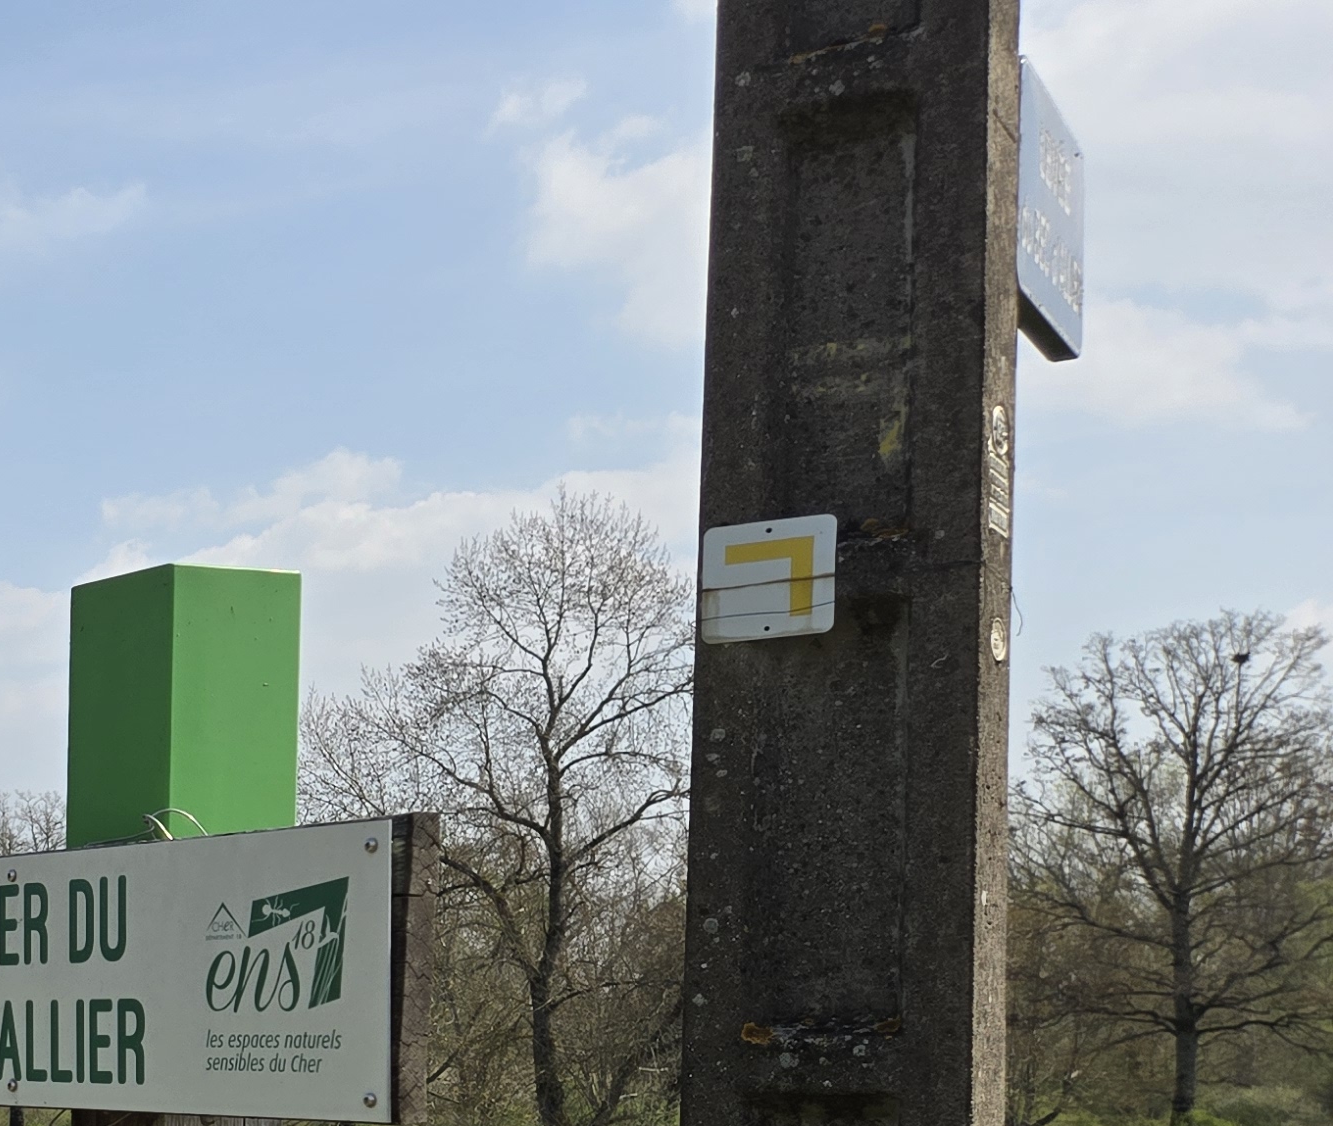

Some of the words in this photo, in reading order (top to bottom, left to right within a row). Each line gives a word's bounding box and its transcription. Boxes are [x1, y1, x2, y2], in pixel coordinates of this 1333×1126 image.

[69, 874, 127, 964] DU
[206, 942, 300, 1013] ens
[291, 919, 316, 950] 18
[205, 1052, 265, 1072] sensibles
[269, 1052, 286, 1073] du
[290, 1053, 322, 1073] Cher
[206, 1029, 224, 1048] les
[228, 1033, 280, 1053] espaces
[284, 1029, 342, 1050] naturels
